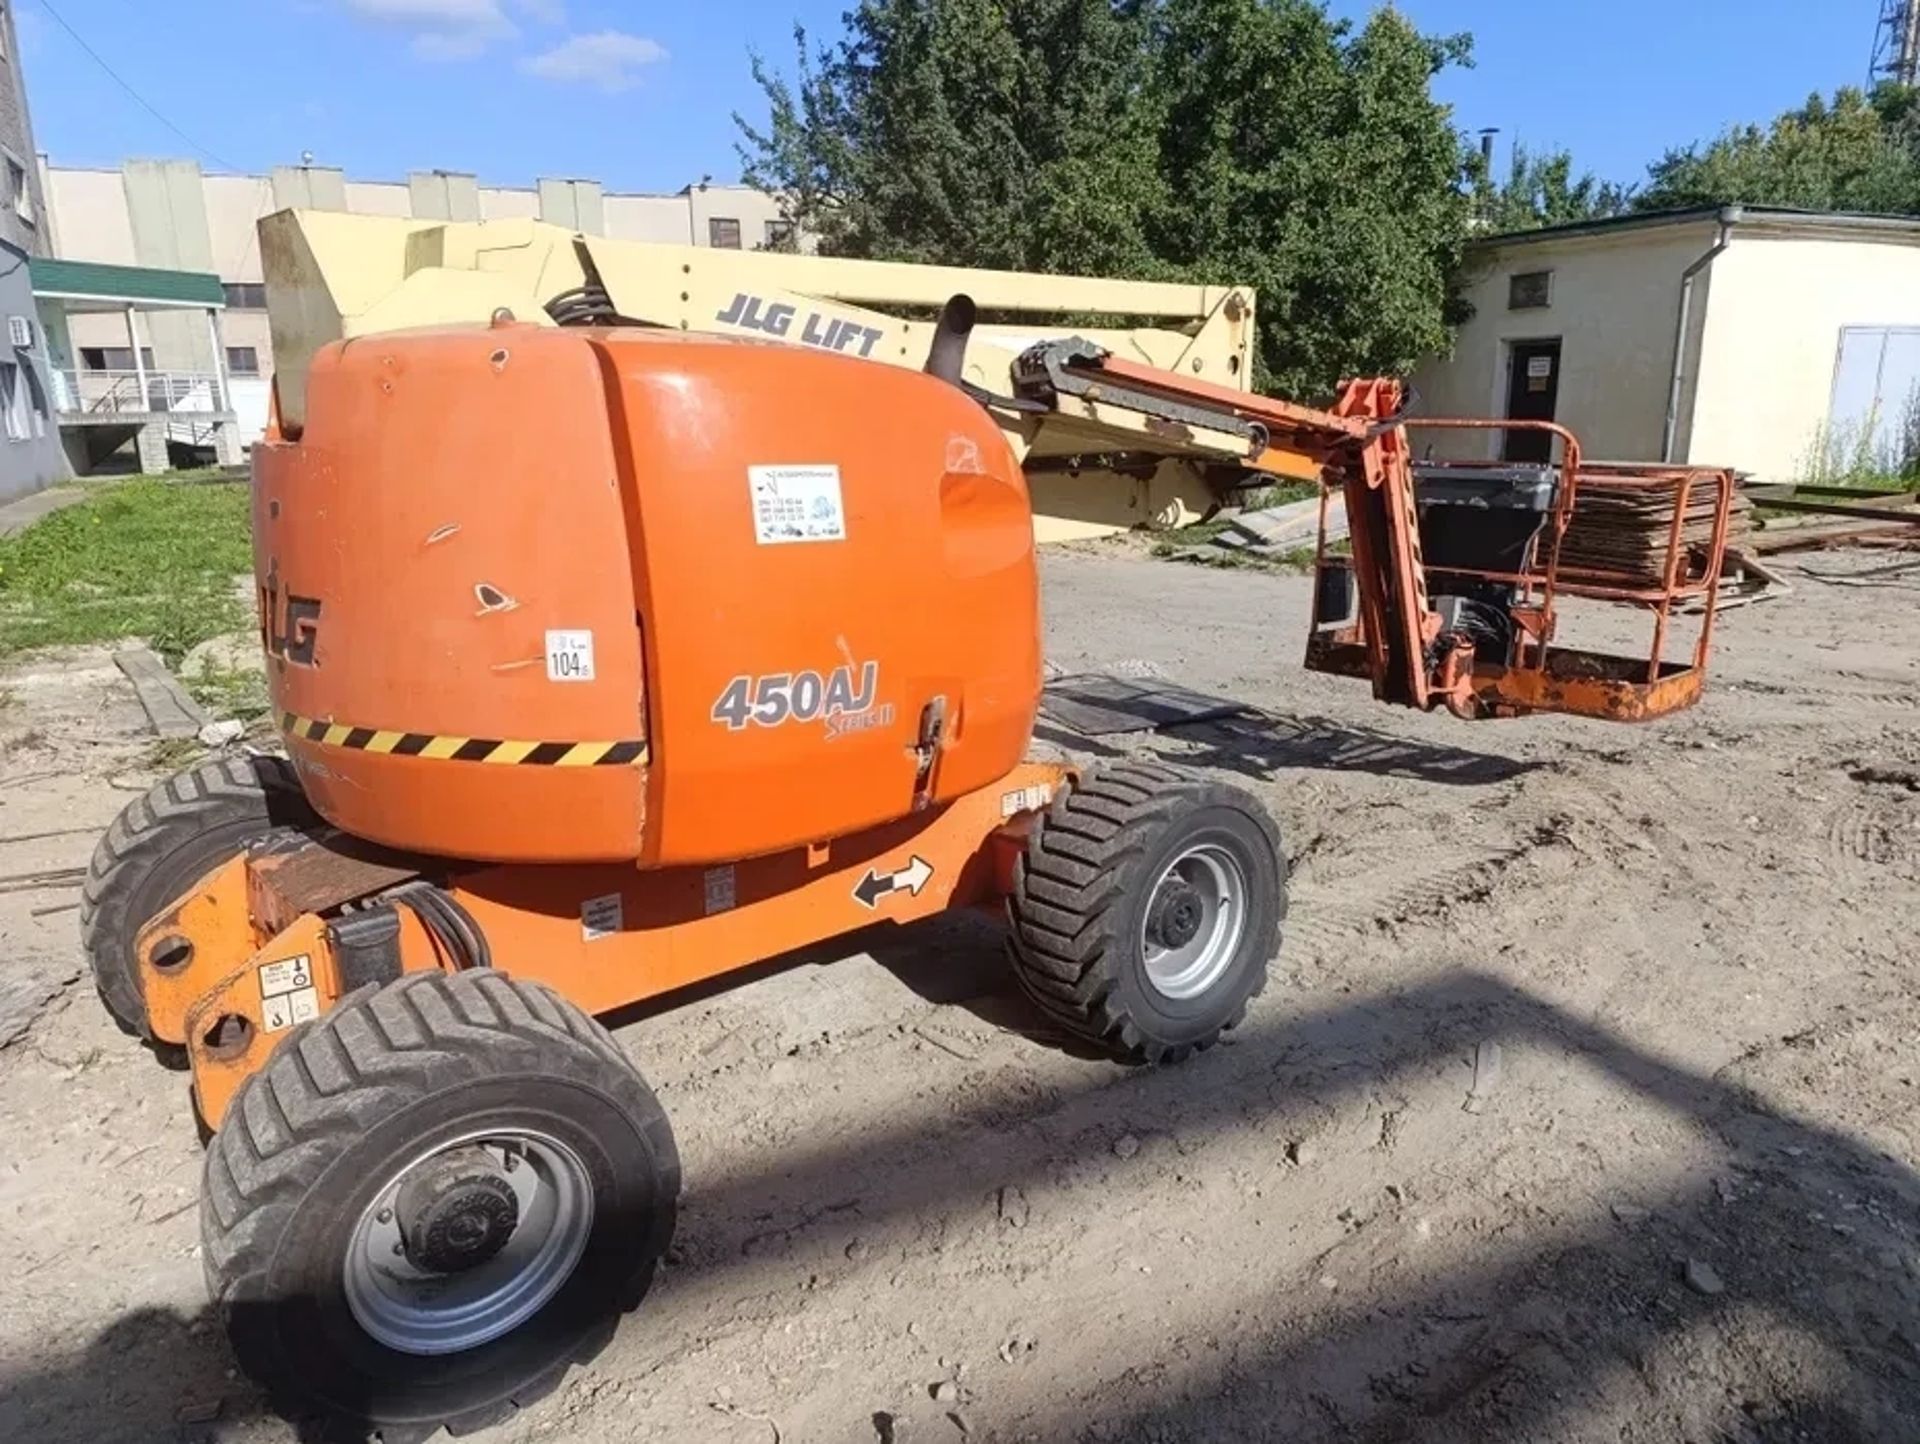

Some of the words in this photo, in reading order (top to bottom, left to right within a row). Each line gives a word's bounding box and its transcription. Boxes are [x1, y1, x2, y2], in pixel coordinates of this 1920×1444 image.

[715, 292, 796, 337] JLG
[800, 313, 883, 358] LIFT
[552, 652, 579, 676] 104
[711, 661, 878, 731] 450AJ
